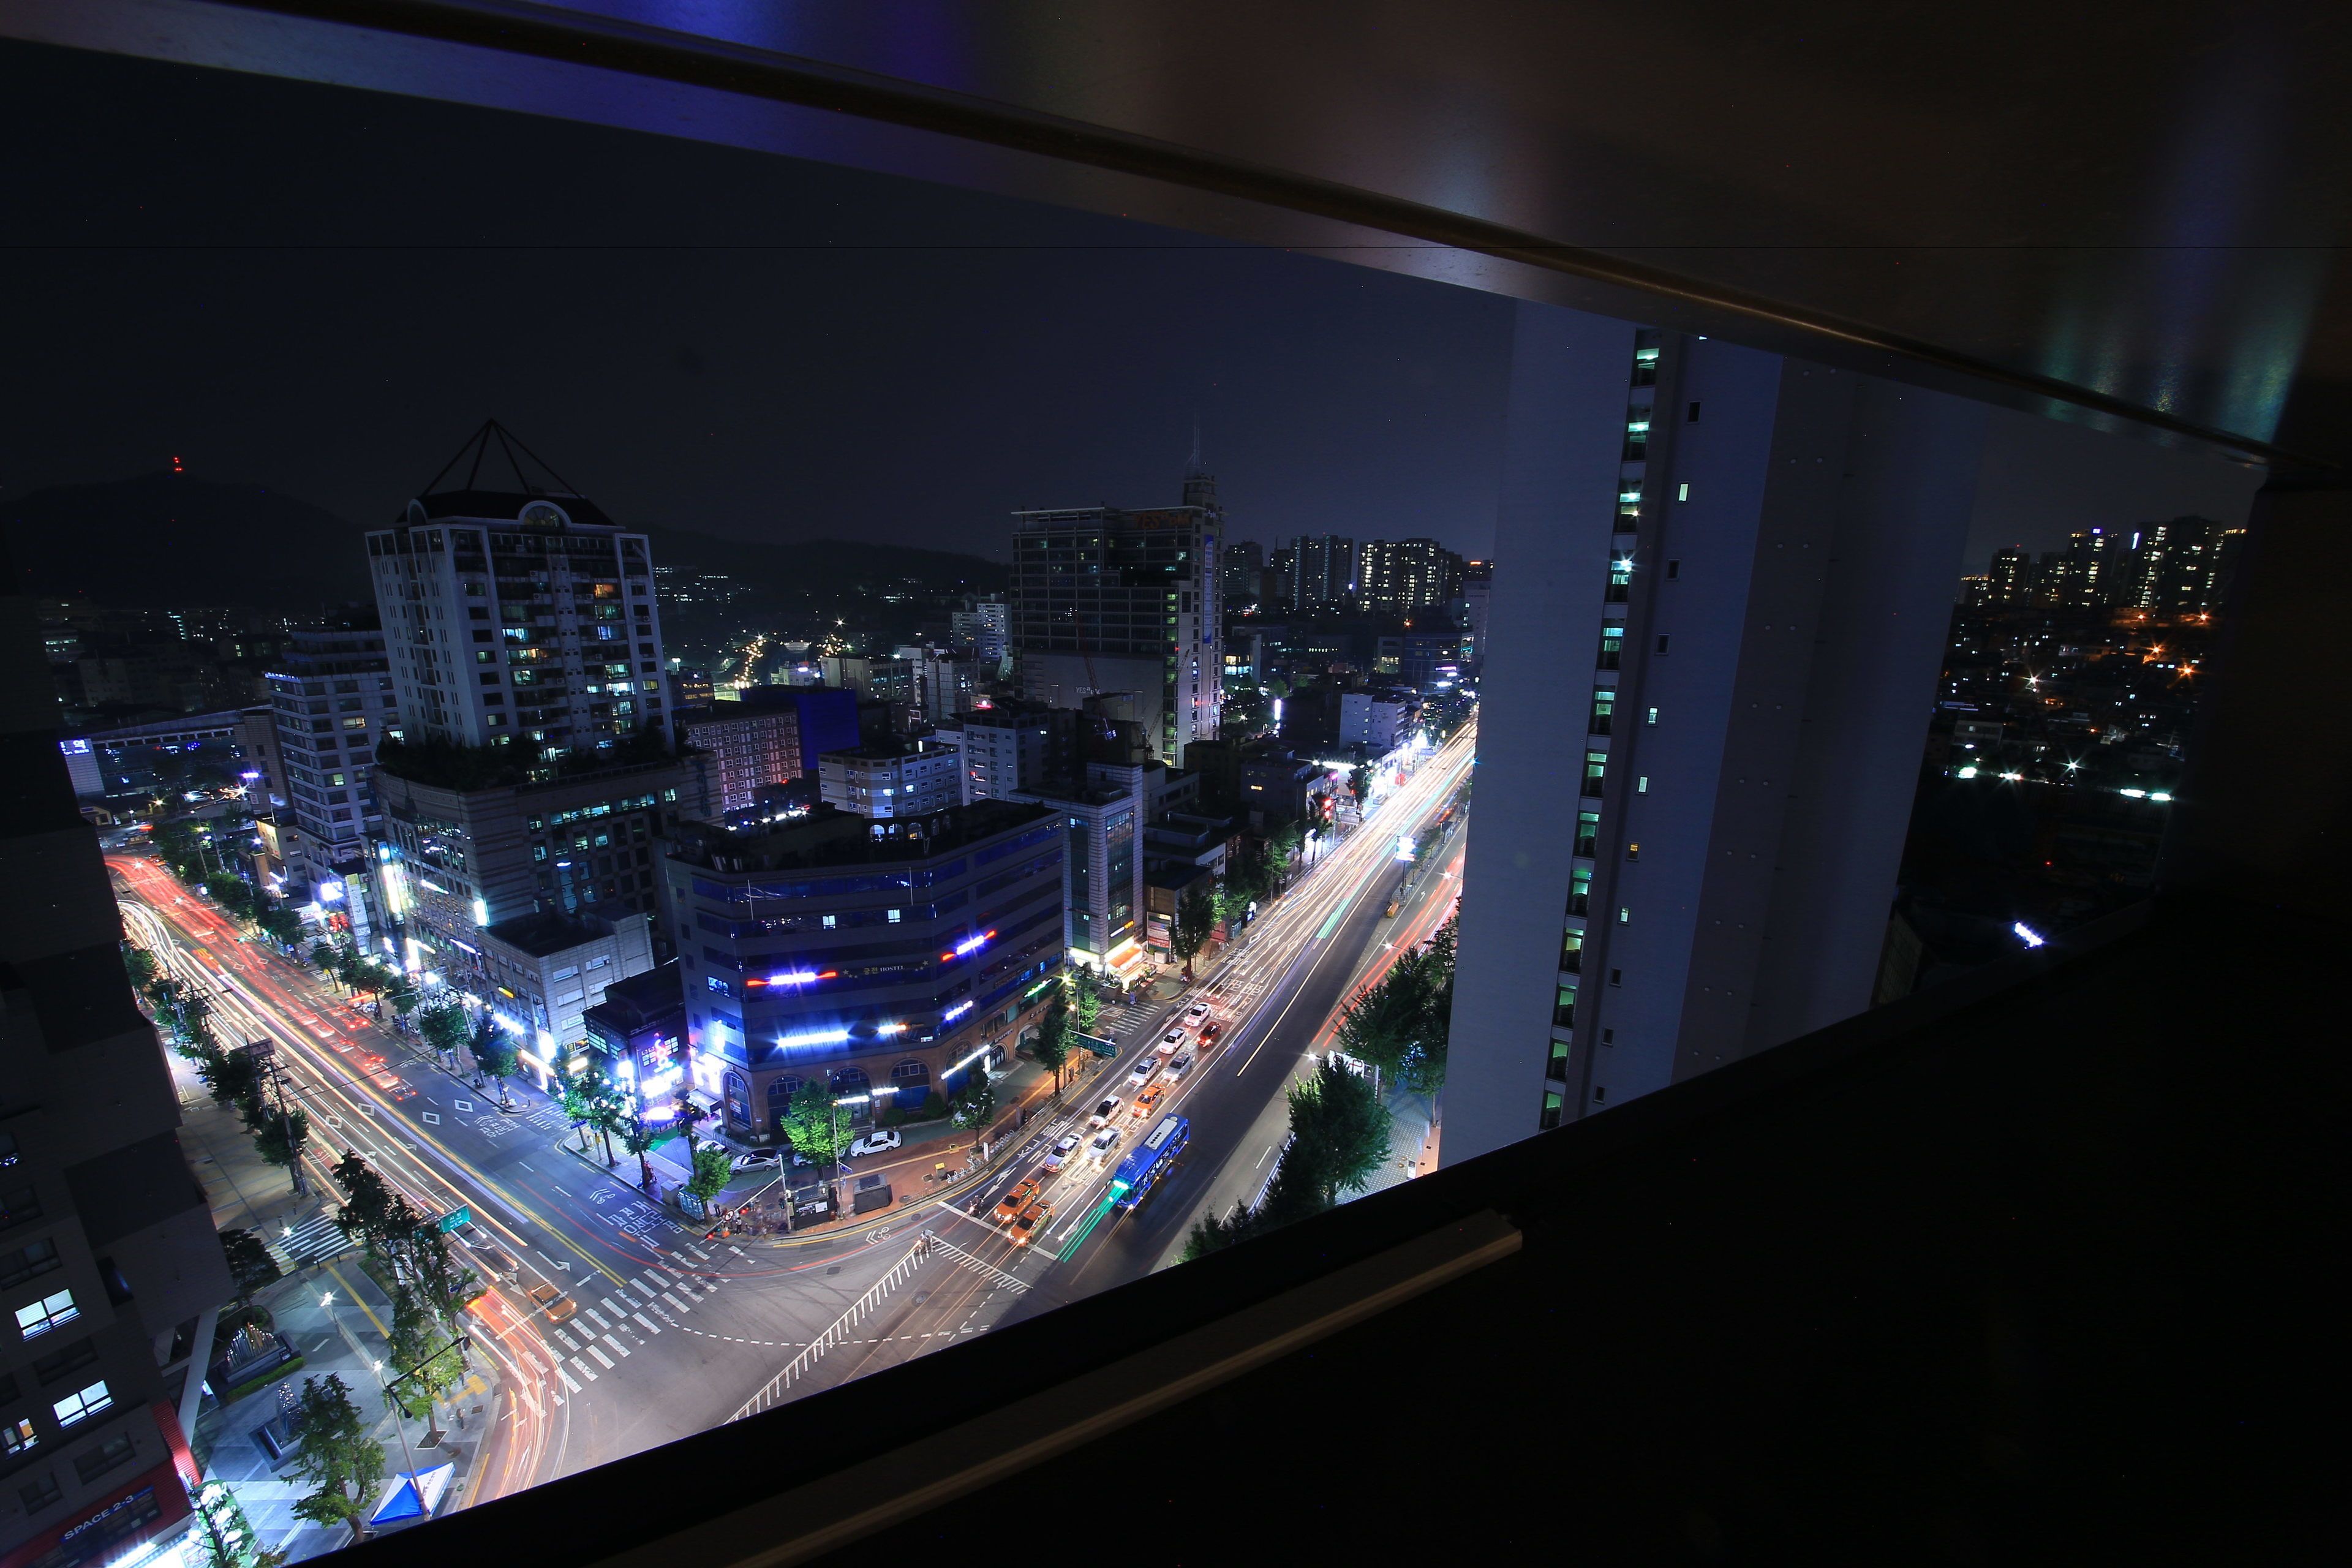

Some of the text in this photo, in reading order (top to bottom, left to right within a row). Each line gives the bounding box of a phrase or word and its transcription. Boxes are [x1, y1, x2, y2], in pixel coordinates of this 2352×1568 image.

[863, 967, 878, 975] 궁전
[478, 1118, 514, 1134] 자전거
[1017, 1139, 1052, 1164] 신촌
[607, 1200, 652, 1227] 자전거
[624, 1210, 667, 1237] 우선도로
[64, 1495, 135, 1540] SPACE 2-3
